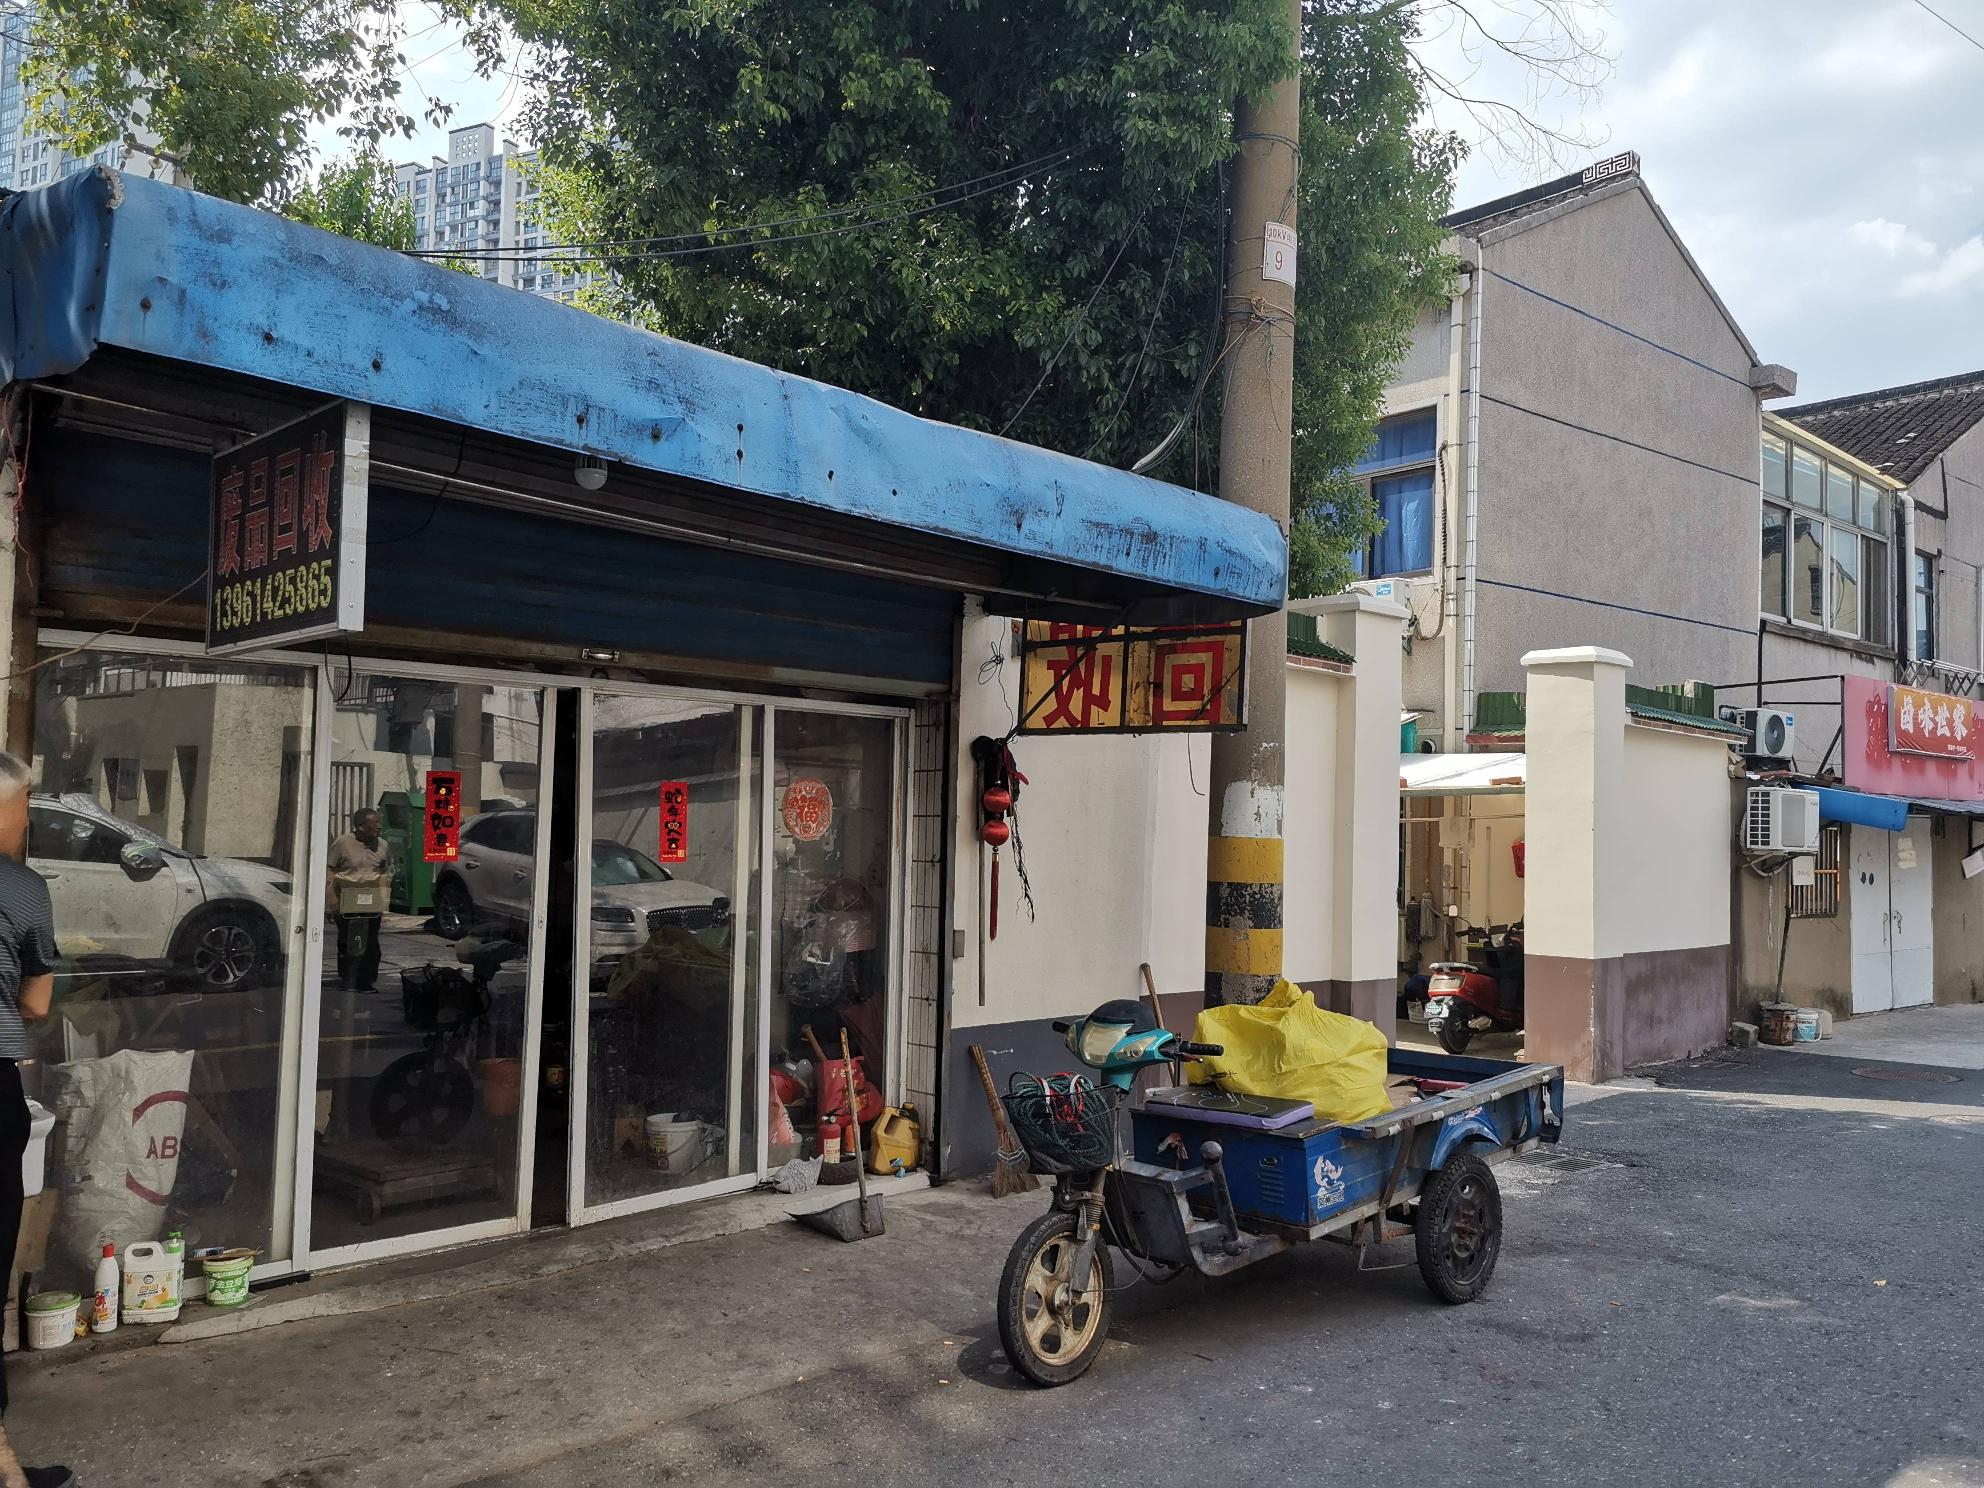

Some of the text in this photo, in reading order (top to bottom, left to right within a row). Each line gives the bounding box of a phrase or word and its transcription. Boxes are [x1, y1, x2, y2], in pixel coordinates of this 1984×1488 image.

[1275, 250, 1283, 271] 9
[217, 430, 334, 578] 废品回收
[215, 559, 332, 632] 13961425865
[1900, 694, 1968, 741] 卤味世家
[796, 793, 821, 825] 福
